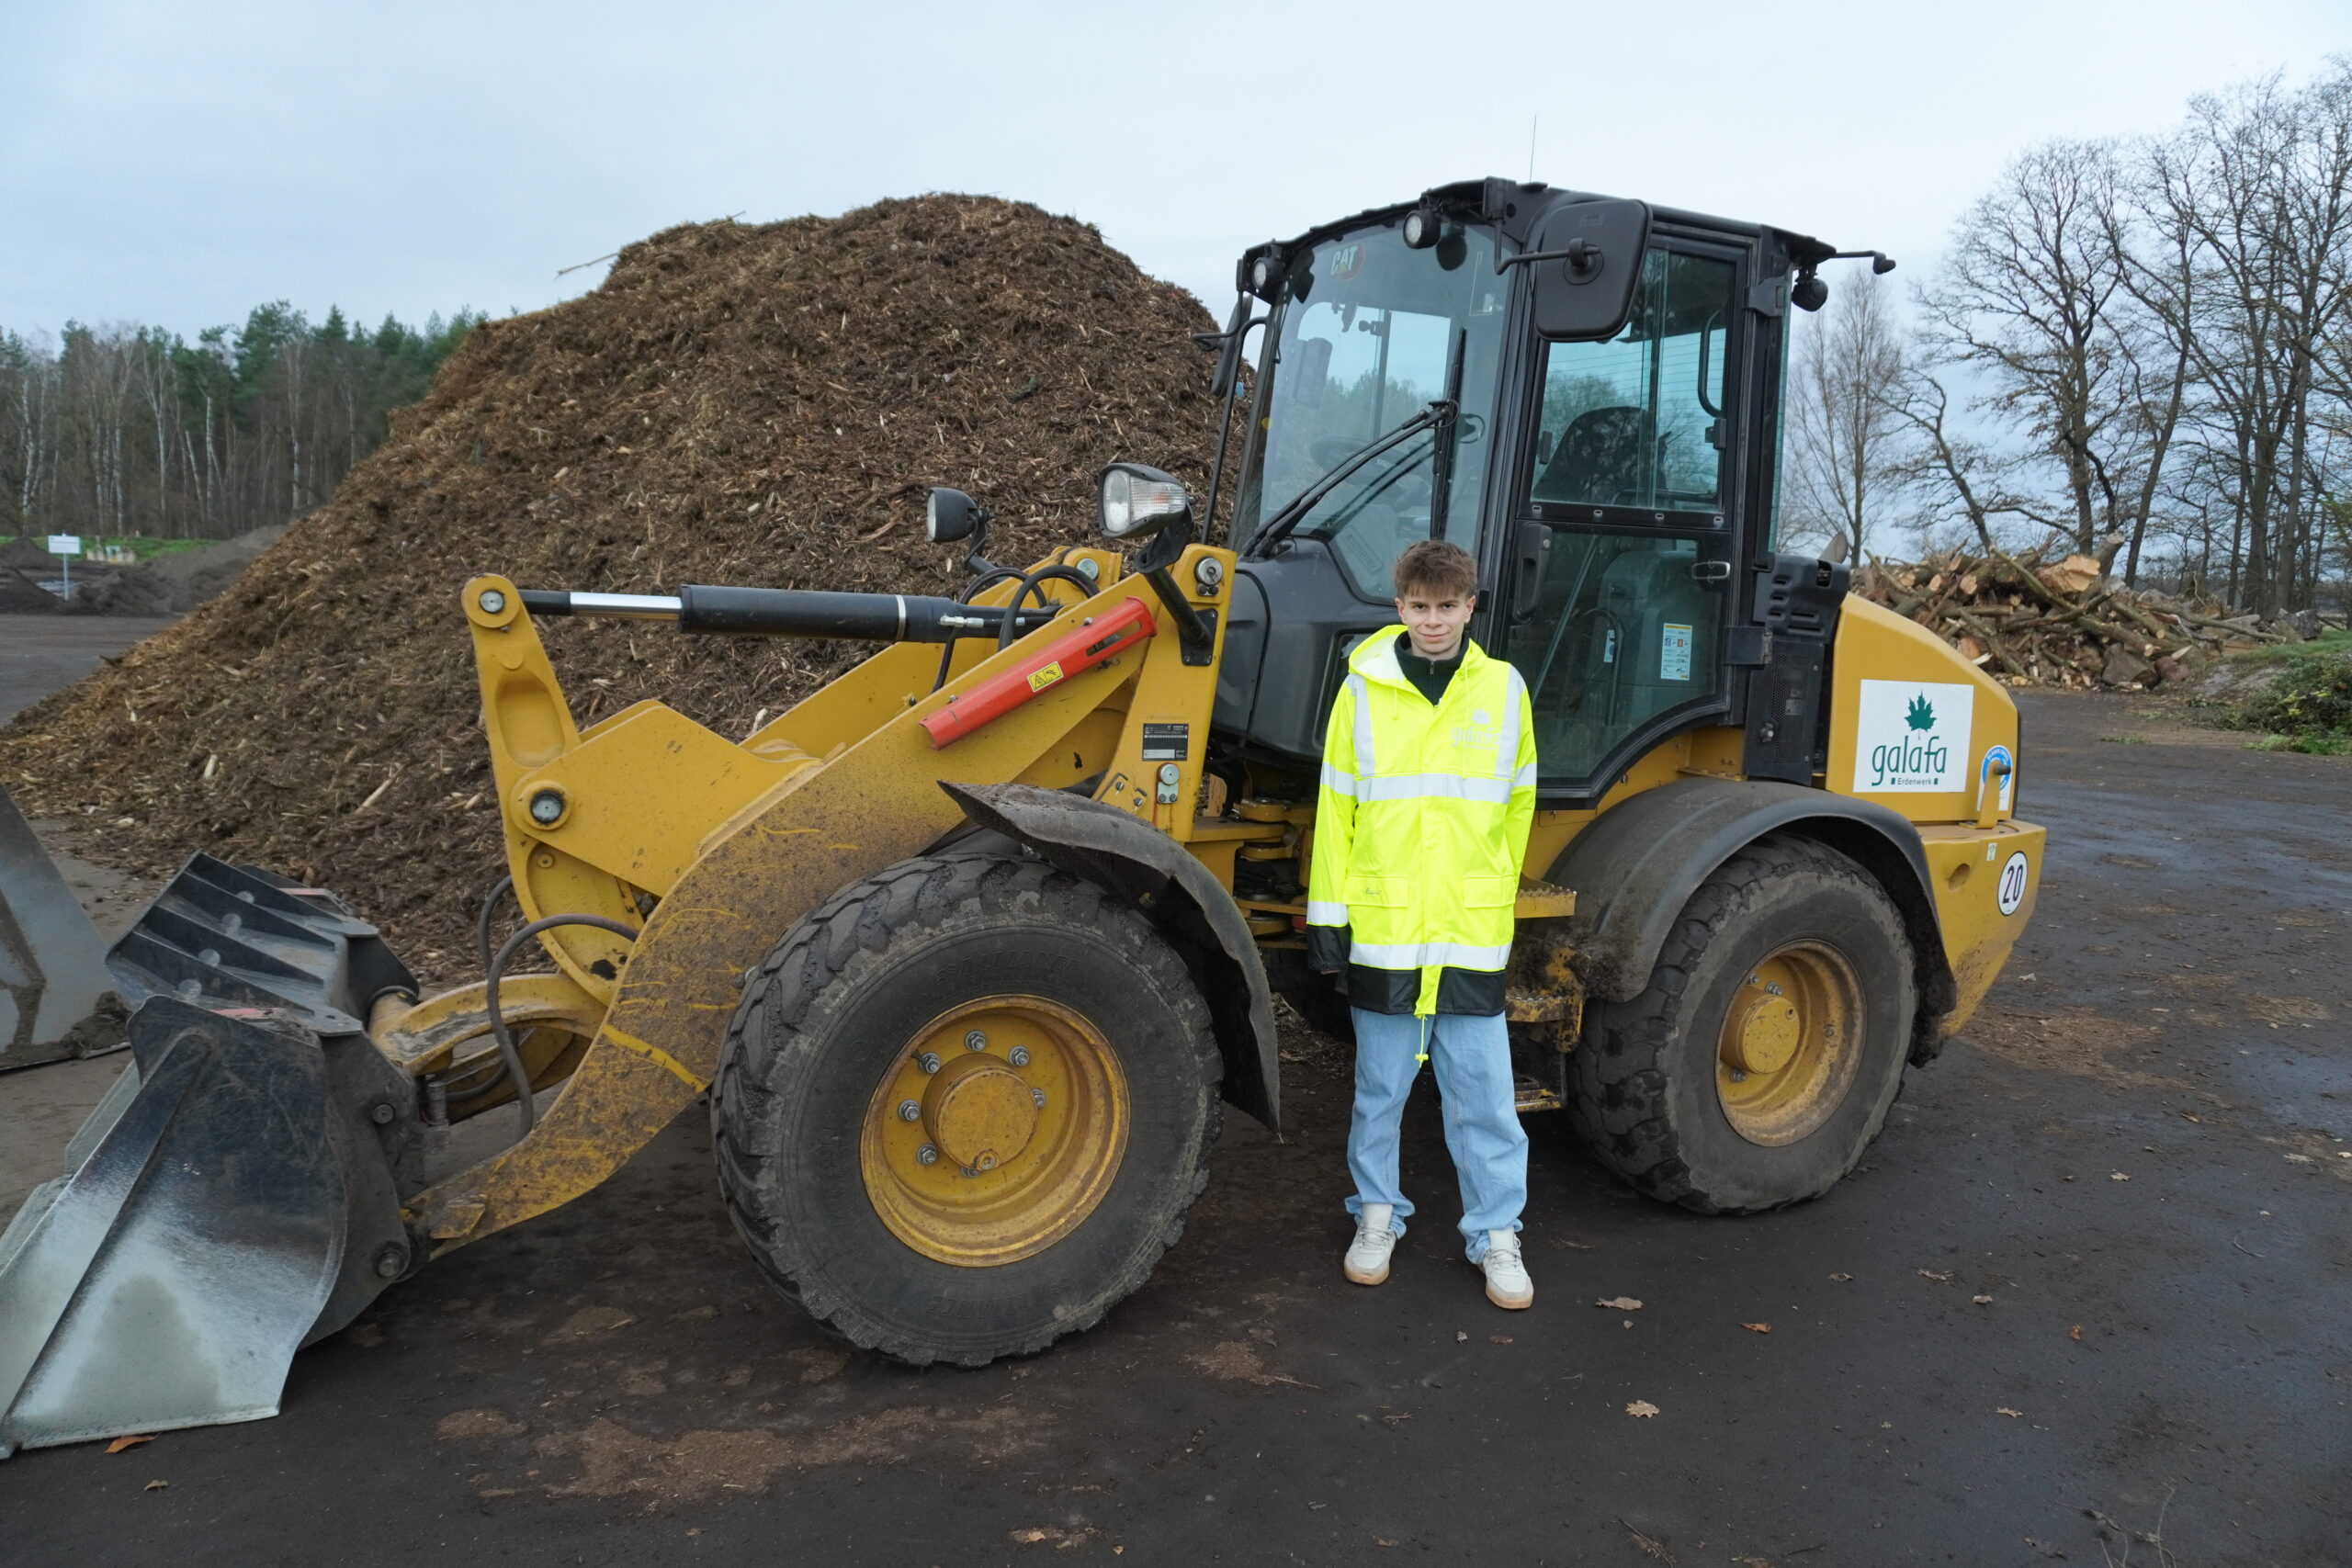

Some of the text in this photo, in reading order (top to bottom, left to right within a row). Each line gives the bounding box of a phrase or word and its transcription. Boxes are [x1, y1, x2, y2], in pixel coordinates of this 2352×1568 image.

[1330, 245, 1358, 276] CAT
[1871, 735, 1947, 786] galafa
[1897, 777, 1933, 785] Erdenwerk
[2003, 864, 2024, 904] 20
